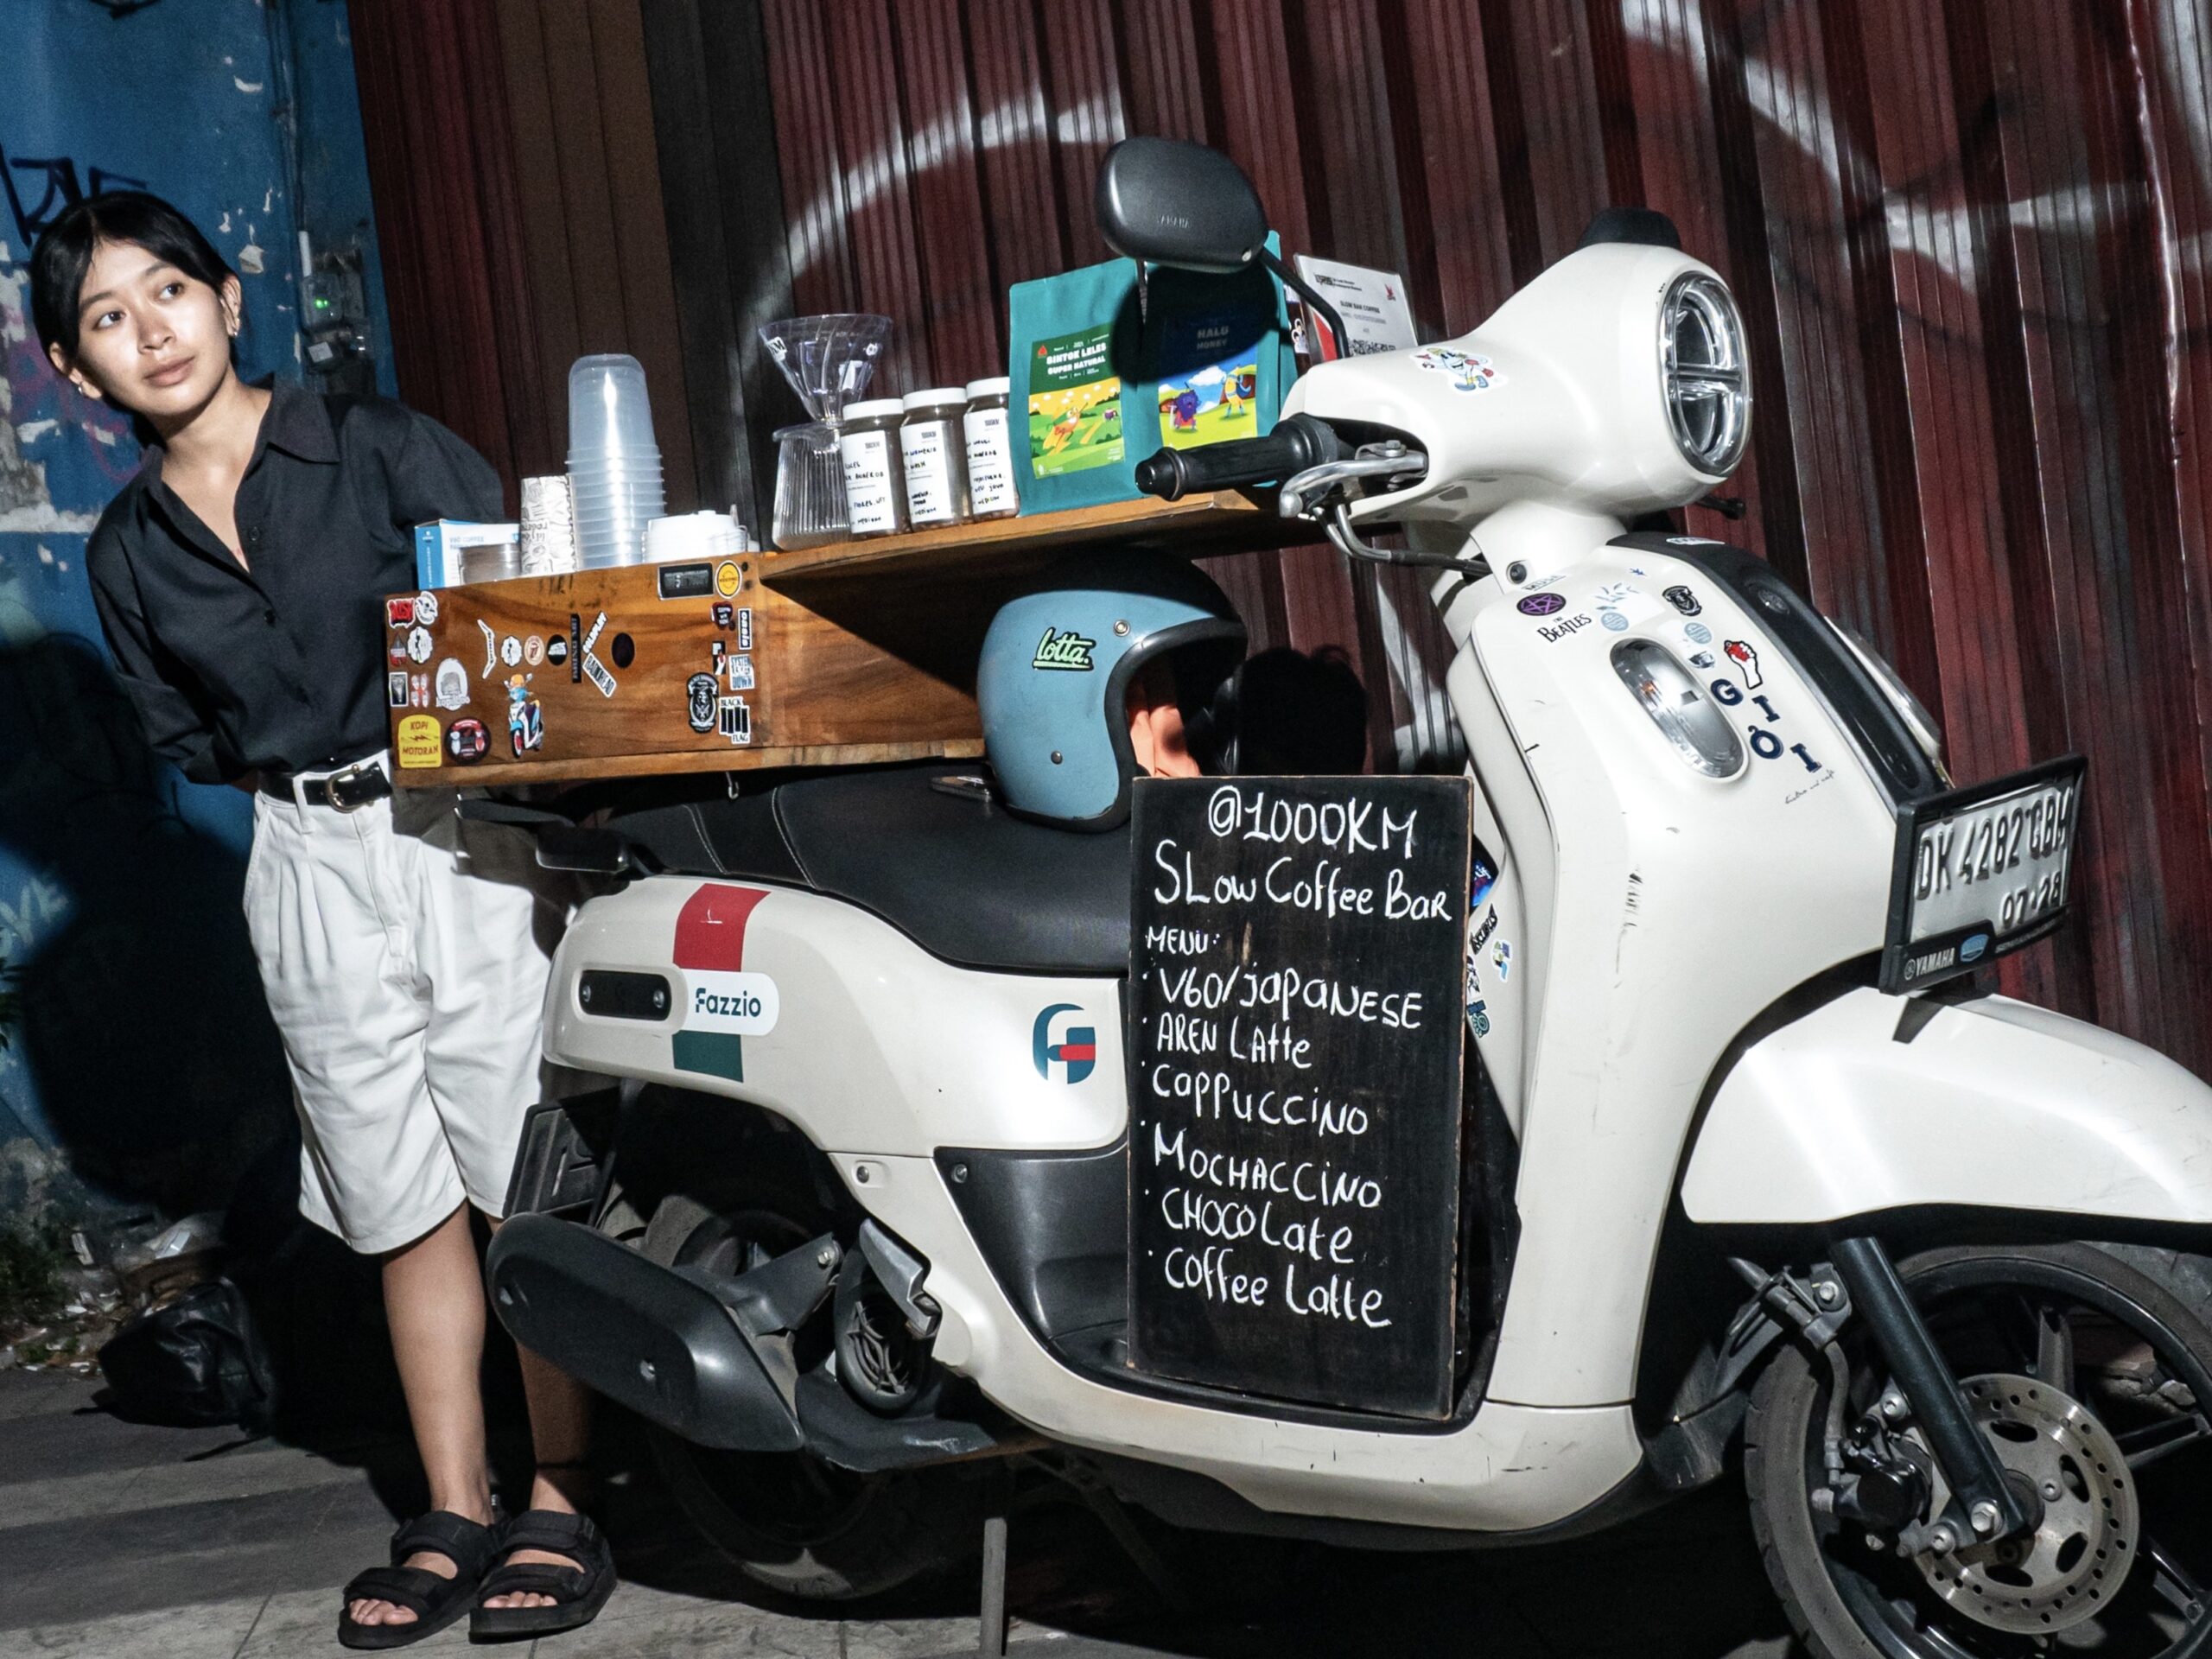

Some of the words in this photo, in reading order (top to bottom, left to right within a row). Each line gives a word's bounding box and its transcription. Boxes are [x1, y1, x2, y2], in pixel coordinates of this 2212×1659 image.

[1197, 340, 1227, 349] HONEY
[1047, 364, 1072, 375] SUPER
[1073, 355, 1106, 370] NATURAL
[1537, 613, 1592, 643] BEATLES
[732, 676, 752, 689] DOWN
[721, 698, 741, 707] BLACK
[410, 721, 429, 731] KOPI
[733, 734, 748, 742] FLAG
[402, 744, 439, 756] MOTORAN
[1209, 785, 1419, 860] @1000KM
[1915, 827, 1954, 900] DK
[1958, 805, 2024, 885] 4282
[1266, 856, 1374, 918] Coffee
[1916, 947, 1955, 977] YAMAHA
[695, 988, 762, 1019] Fazzio
[1157, 1012, 1217, 1054] AREN
[1166, 1246, 1268, 1306] Coffee
[1286, 1264, 1392, 1328] Latte
